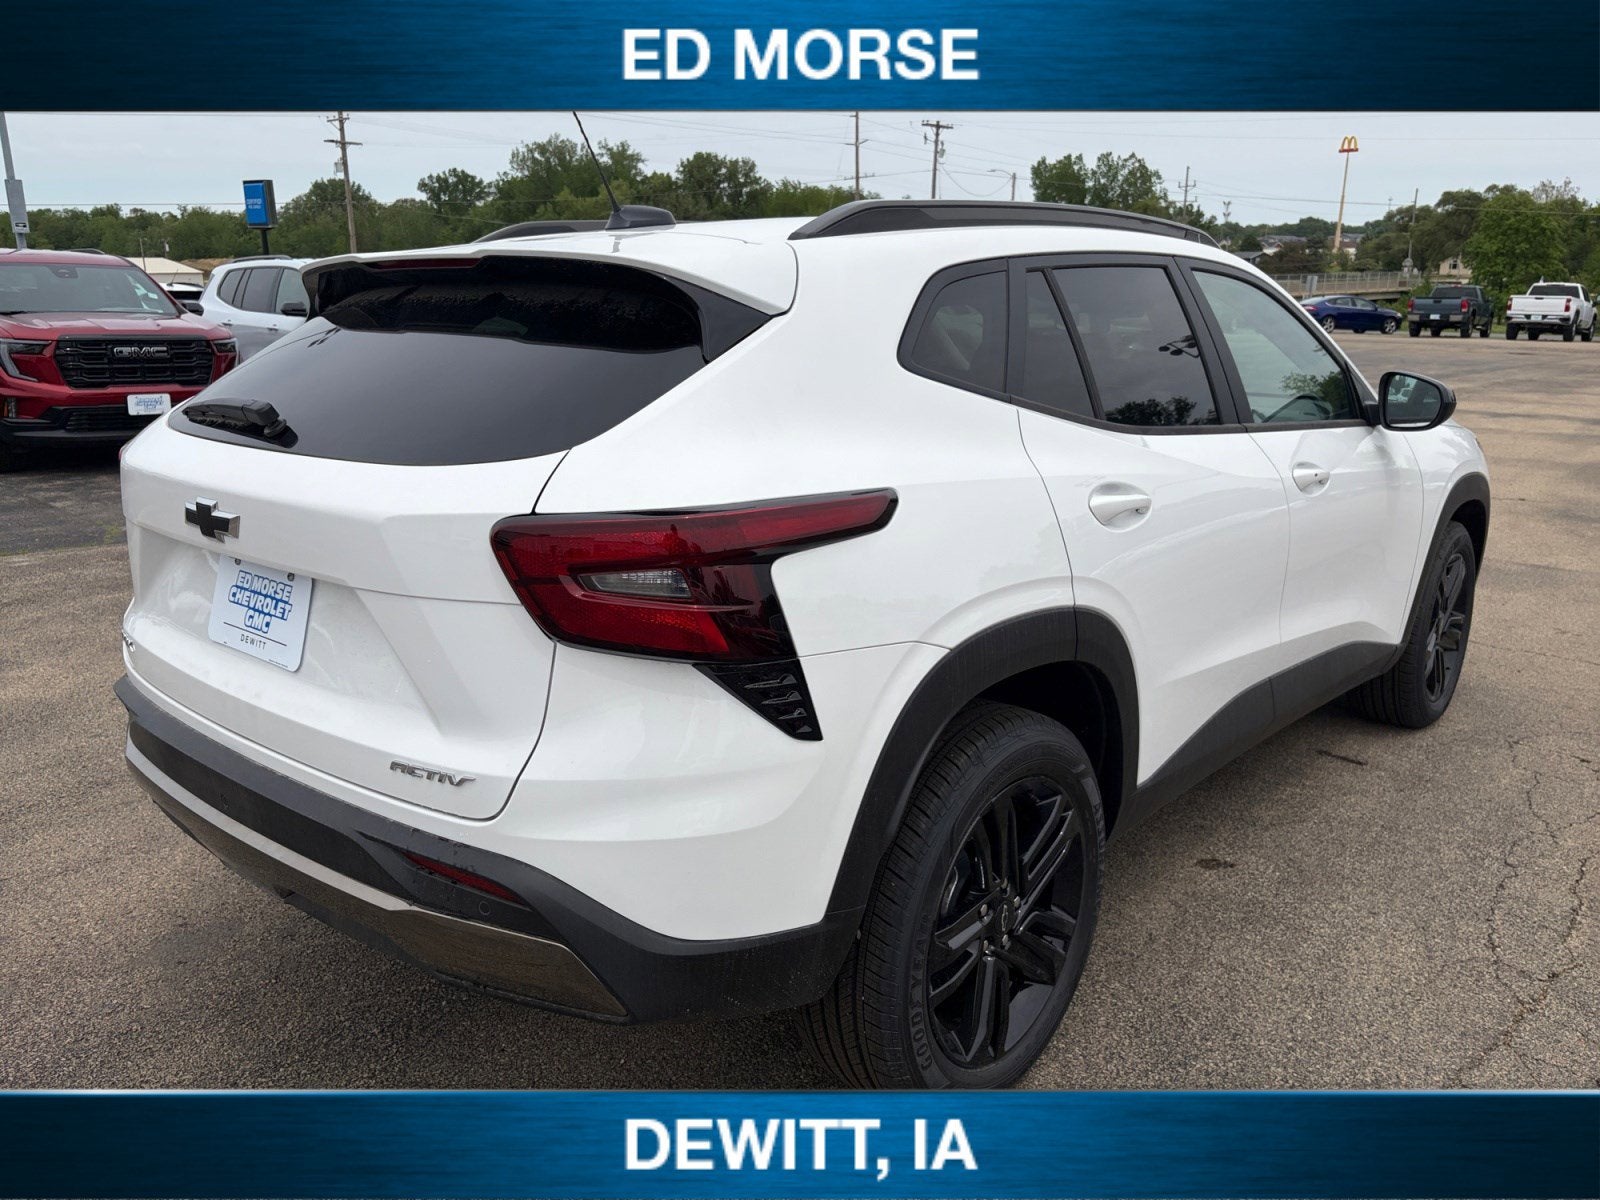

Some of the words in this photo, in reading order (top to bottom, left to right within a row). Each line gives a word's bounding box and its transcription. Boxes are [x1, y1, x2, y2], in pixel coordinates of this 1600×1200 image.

[113, 346, 169, 358] GMC
[236, 570, 252, 589] ED
[252, 575, 293, 602] MORSE
[228, 585, 292, 621] CHEVROLET
[244, 609, 272, 634] GMC
[240, 633, 267, 650] DEWITT
[390, 760, 477, 787] ACTIV
